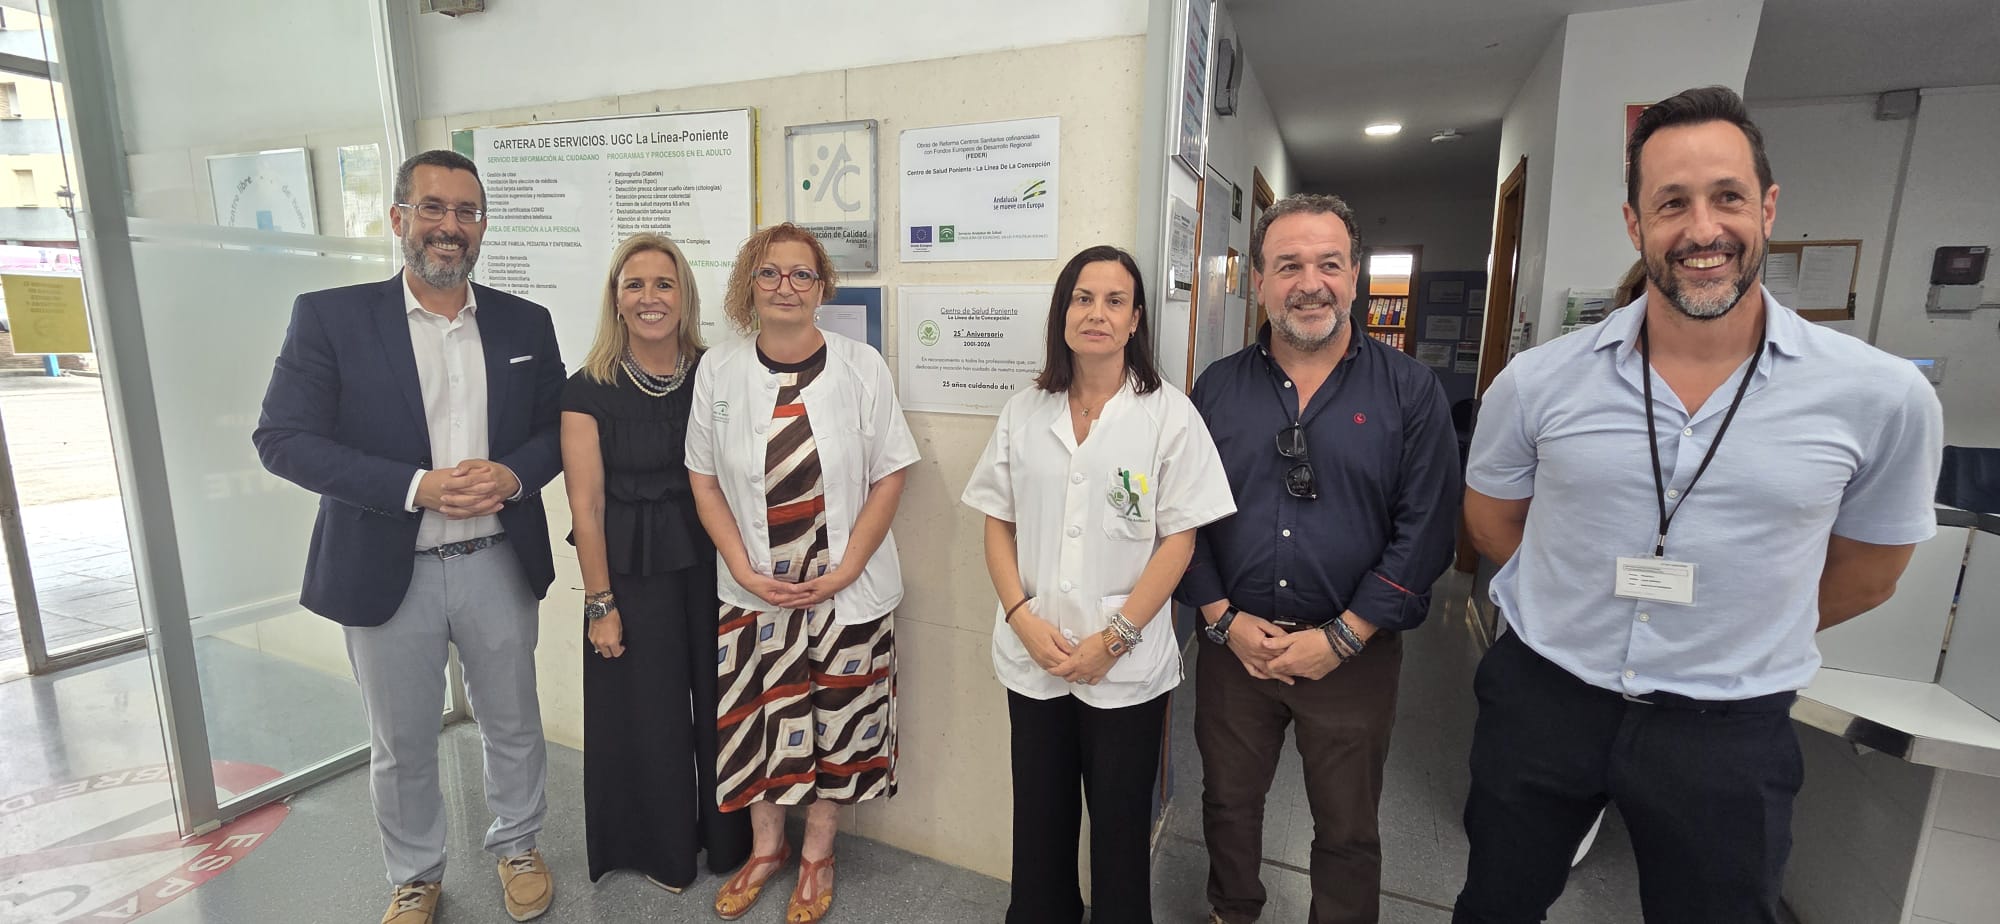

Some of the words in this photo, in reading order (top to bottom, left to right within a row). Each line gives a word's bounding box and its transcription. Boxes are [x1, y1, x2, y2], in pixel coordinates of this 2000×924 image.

[494, 139, 536, 149] CARTERA
[538, 138, 551, 148] DE
[553, 135, 608, 148] SERVICIOS.
[611, 134, 633, 145] UGC
[636, 133, 648, 144] La
[1010, 142, 1032, 150] Regional
[651, 150, 685, 158] PROCESOS
[697, 149, 704, 157] EL
[706, 148, 732, 156] ADULTO
[1027, 202, 1044, 210] Europa
[812, 231, 832, 239] tación
[843, 230, 867, 238] Calidad
[689, 260, 735, 268] MATERNO-INFA
[941, 307, 961, 315] Centro
[963, 307, 970, 315] de
[972, 307, 989, 315] Salud
[991, 308, 1018, 316] Poniente
